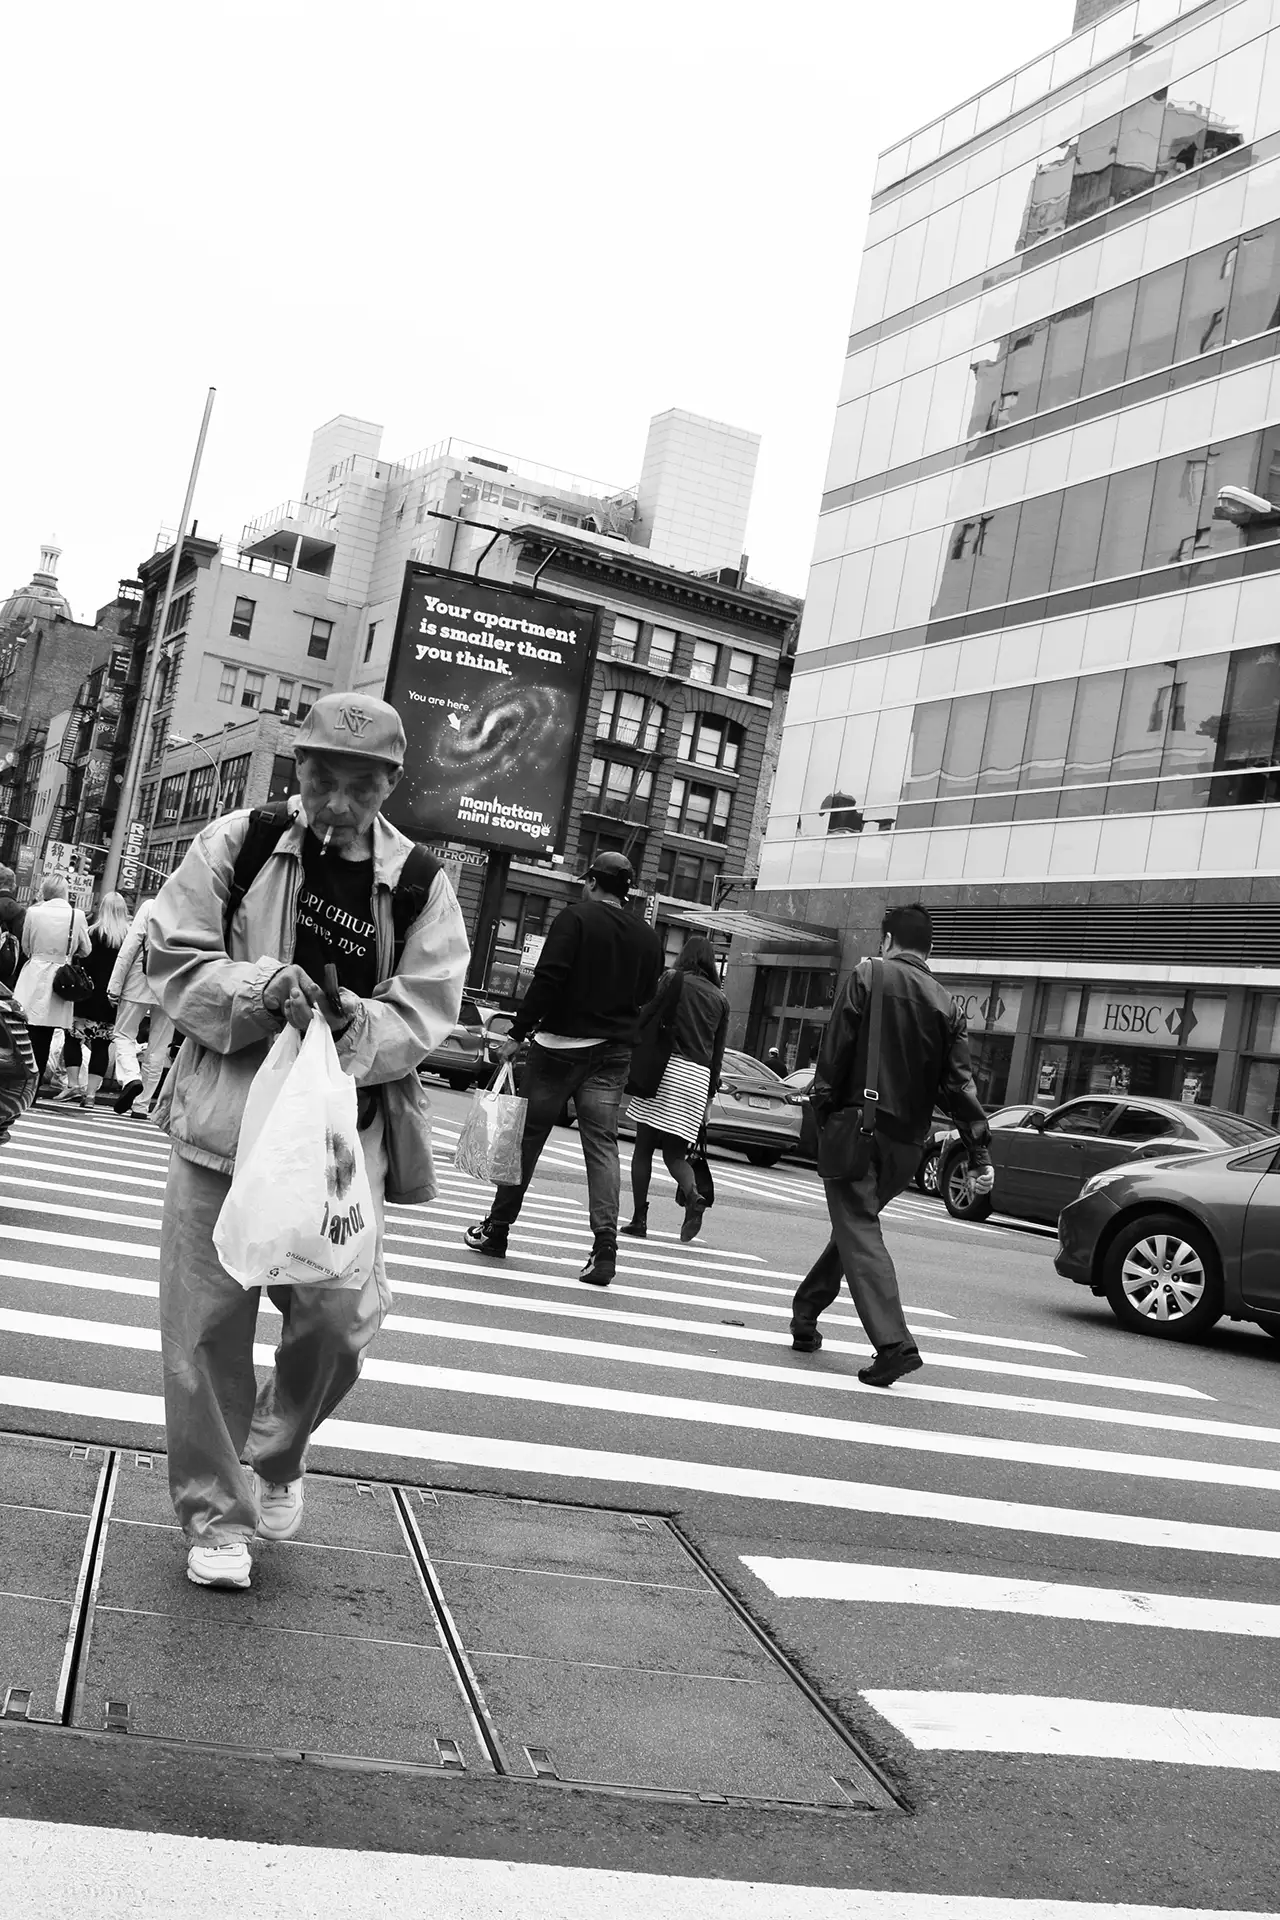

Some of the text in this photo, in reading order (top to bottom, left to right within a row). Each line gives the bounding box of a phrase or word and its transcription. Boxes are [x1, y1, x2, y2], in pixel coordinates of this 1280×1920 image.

[424, 595, 578, 645] Your apartment
[418, 617, 562, 664] is smaller than
[415, 642, 513, 676] you think.
[408, 690, 471, 712] You are here.
[334, 706, 373, 739] NY
[457, 807, 551, 840] mini storage
[459, 795, 543, 823] manhattan
[325, 904, 377, 942] CHIUP
[338, 937, 367, 958] nyc
[1103, 1003, 1162, 1034] HSBC
